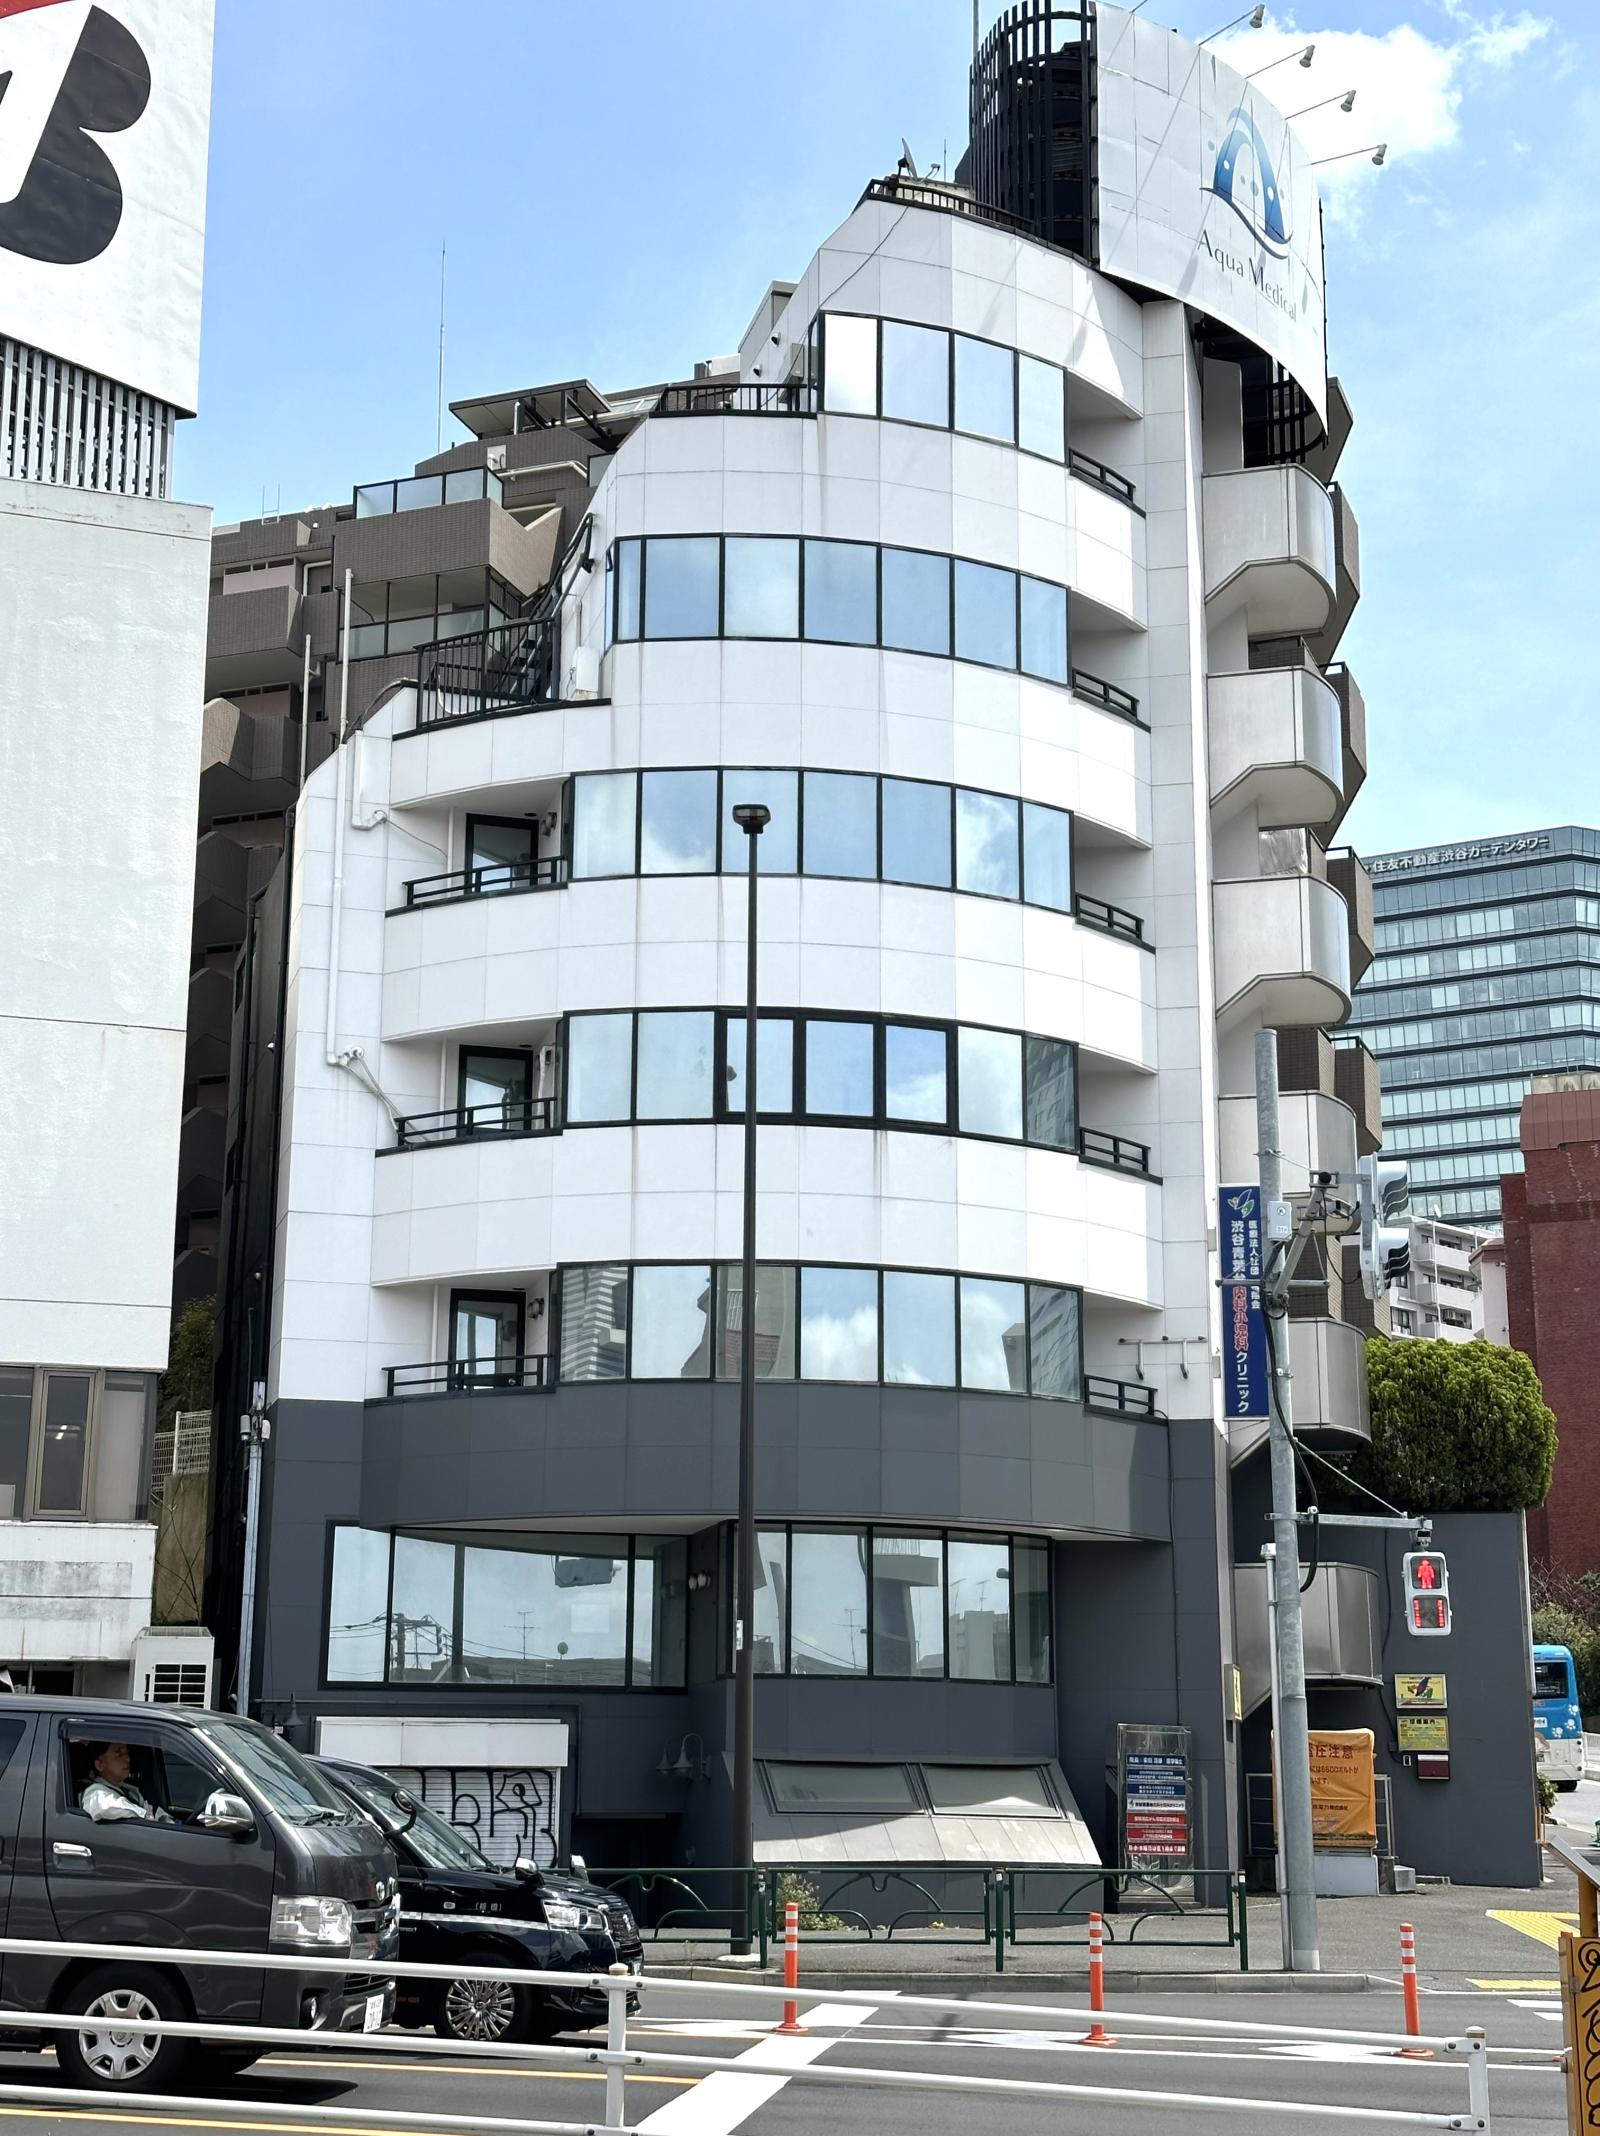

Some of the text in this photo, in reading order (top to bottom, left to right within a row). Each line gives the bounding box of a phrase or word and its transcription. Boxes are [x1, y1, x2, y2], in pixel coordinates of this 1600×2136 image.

[1197, 229, 1297, 322] Aqua Medical
[1372, 836, 1550, 873] 住友不動産渋谷ガーデンタワー
